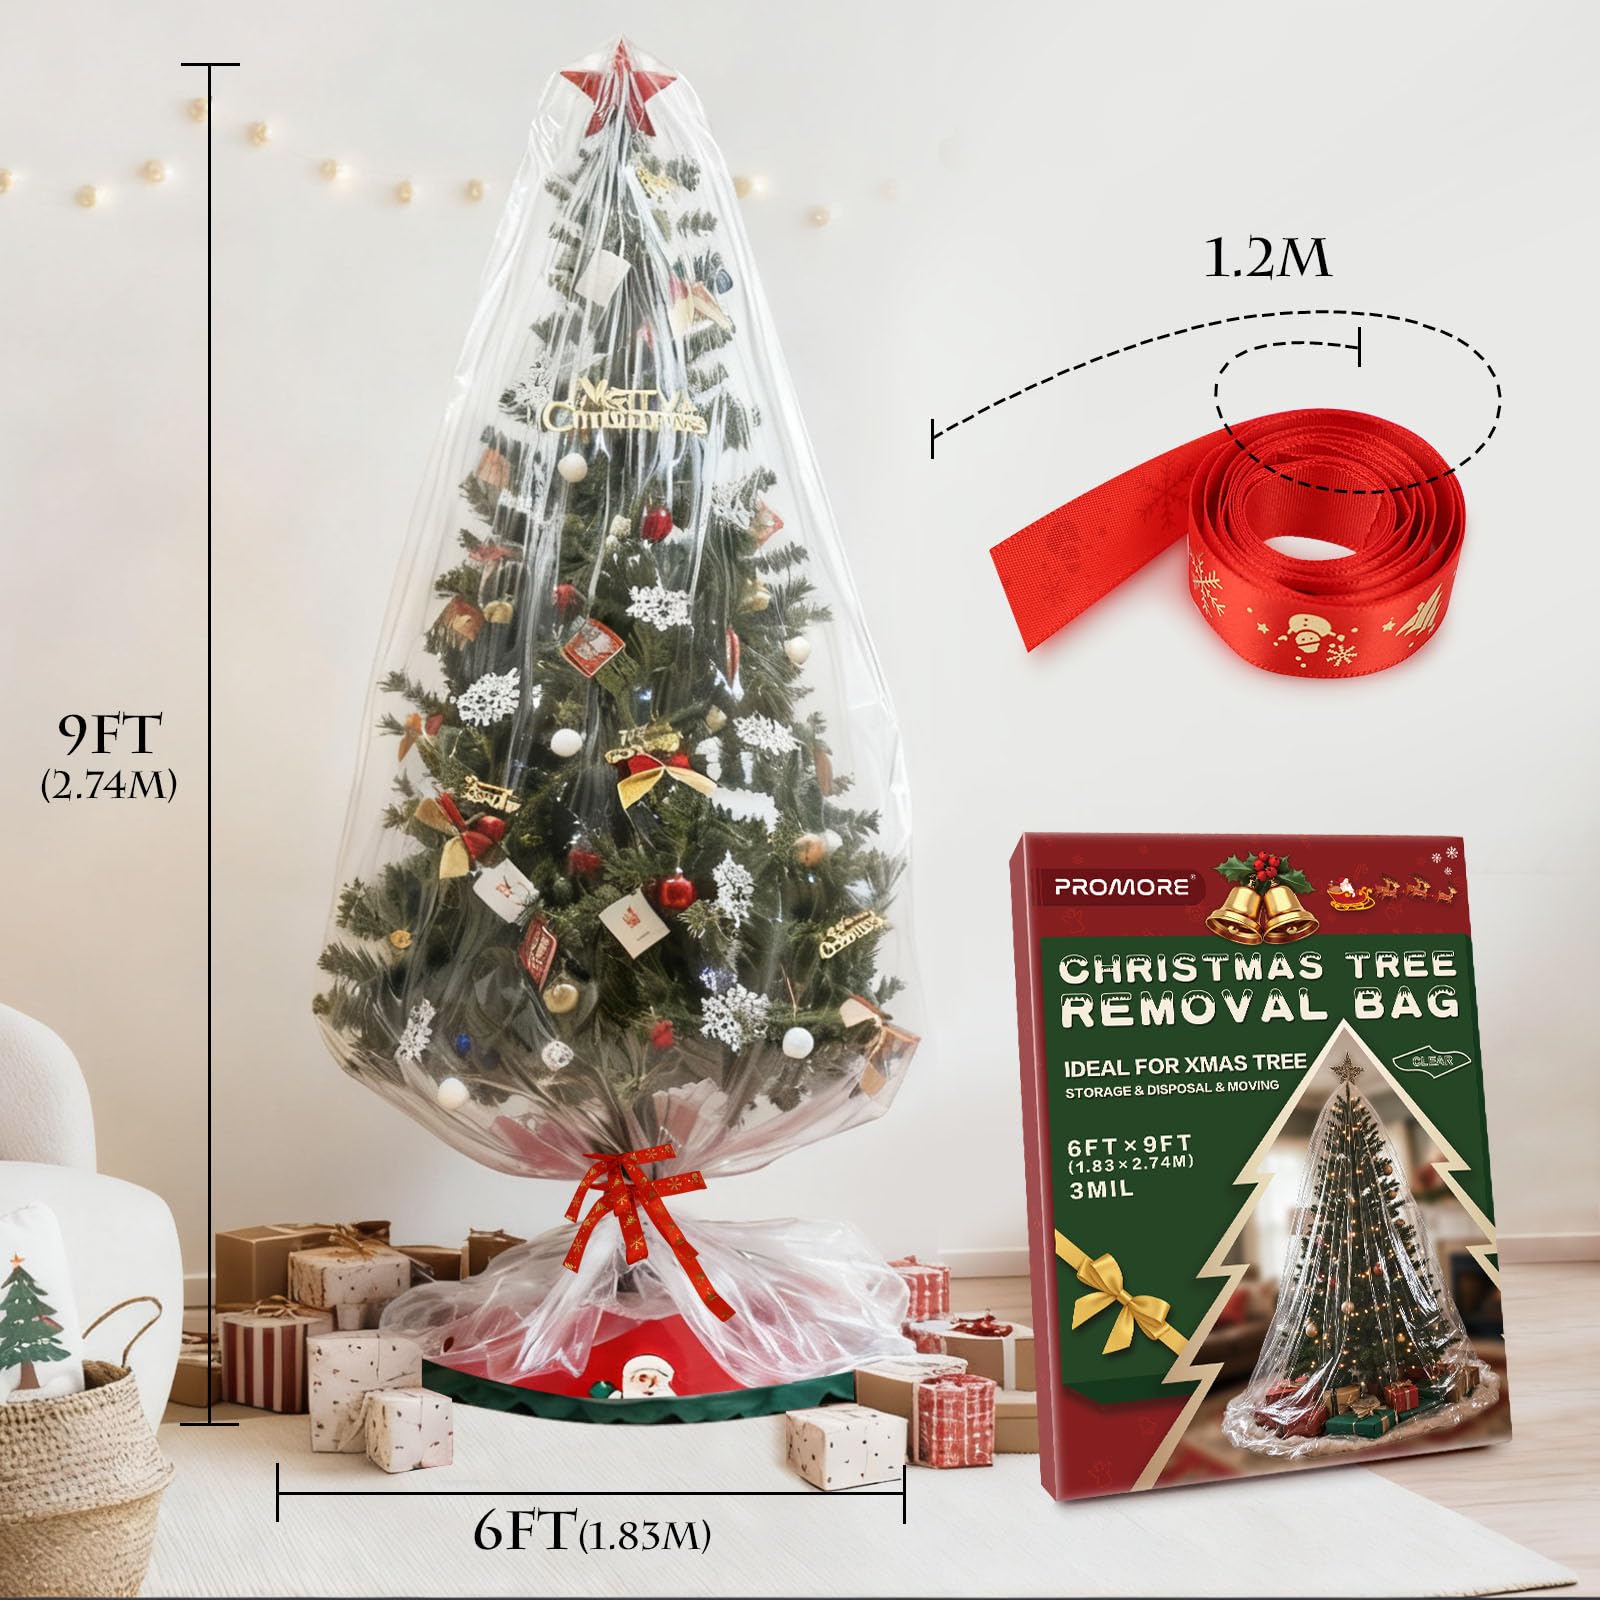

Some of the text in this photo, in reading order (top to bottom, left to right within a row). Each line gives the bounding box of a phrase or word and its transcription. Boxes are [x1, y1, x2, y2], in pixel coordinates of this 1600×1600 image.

[1059, 950, 1457, 985] CHRISTMAS TREE
[1060, 985, 1459, 1029] REMOVAL BAG
[1064, 1052, 1308, 1078] IDEAL FOR XMAS TREE
[1412, 1055, 1454, 1067] CLEAR
[1065, 1079, 1280, 1099] STORAGE & DISPOSAL & MOVING
[1070, 1179, 1134, 1200] 3MIL
